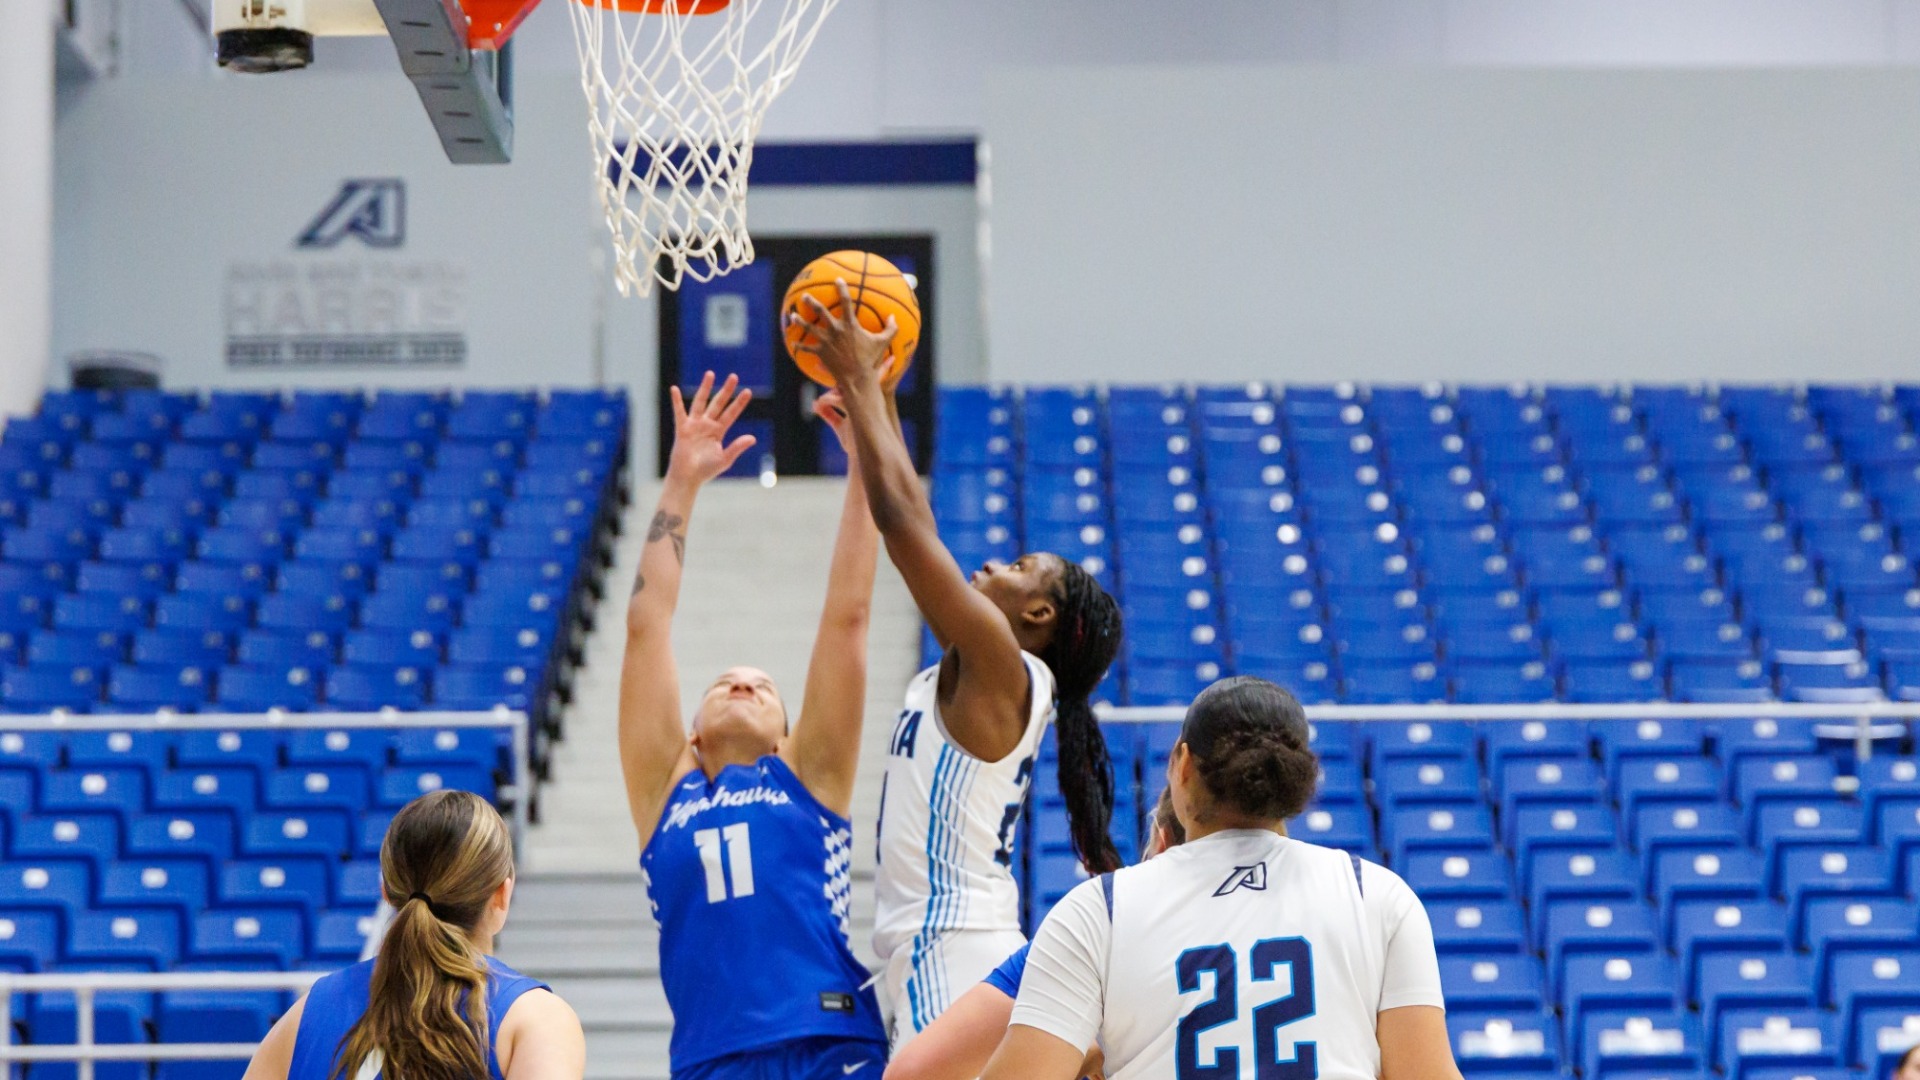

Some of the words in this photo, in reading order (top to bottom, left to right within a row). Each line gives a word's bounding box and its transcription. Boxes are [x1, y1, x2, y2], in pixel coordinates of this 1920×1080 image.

[226, 284, 464, 333] HARRIS
[693, 820, 756, 904] 11
[1174, 935, 1319, 1080] 22
